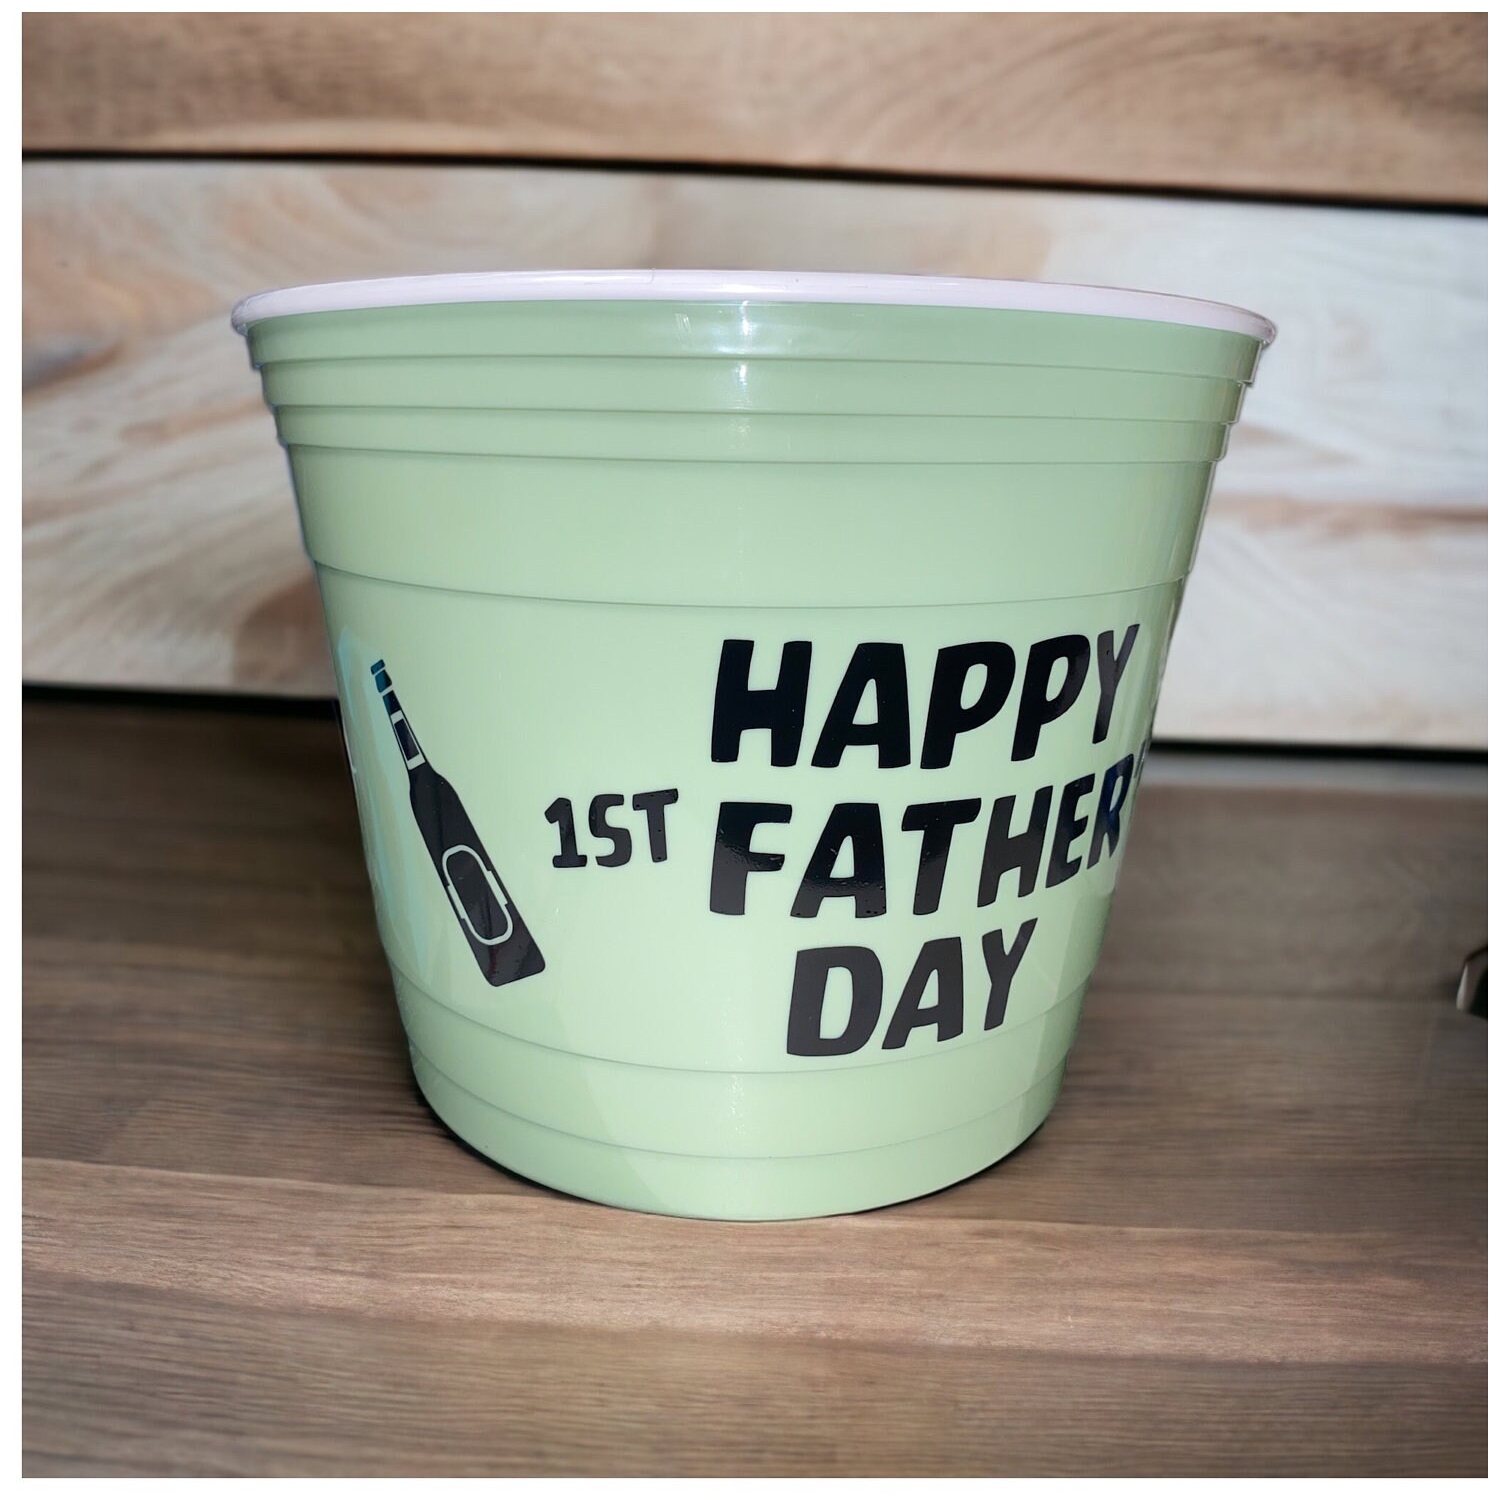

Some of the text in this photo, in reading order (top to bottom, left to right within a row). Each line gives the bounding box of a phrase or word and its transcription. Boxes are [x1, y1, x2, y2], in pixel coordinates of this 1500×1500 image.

[711, 624, 1140, 769] HAPPY
[545, 789, 679, 868] 1ST
[787, 918, 1038, 1056] DAY
